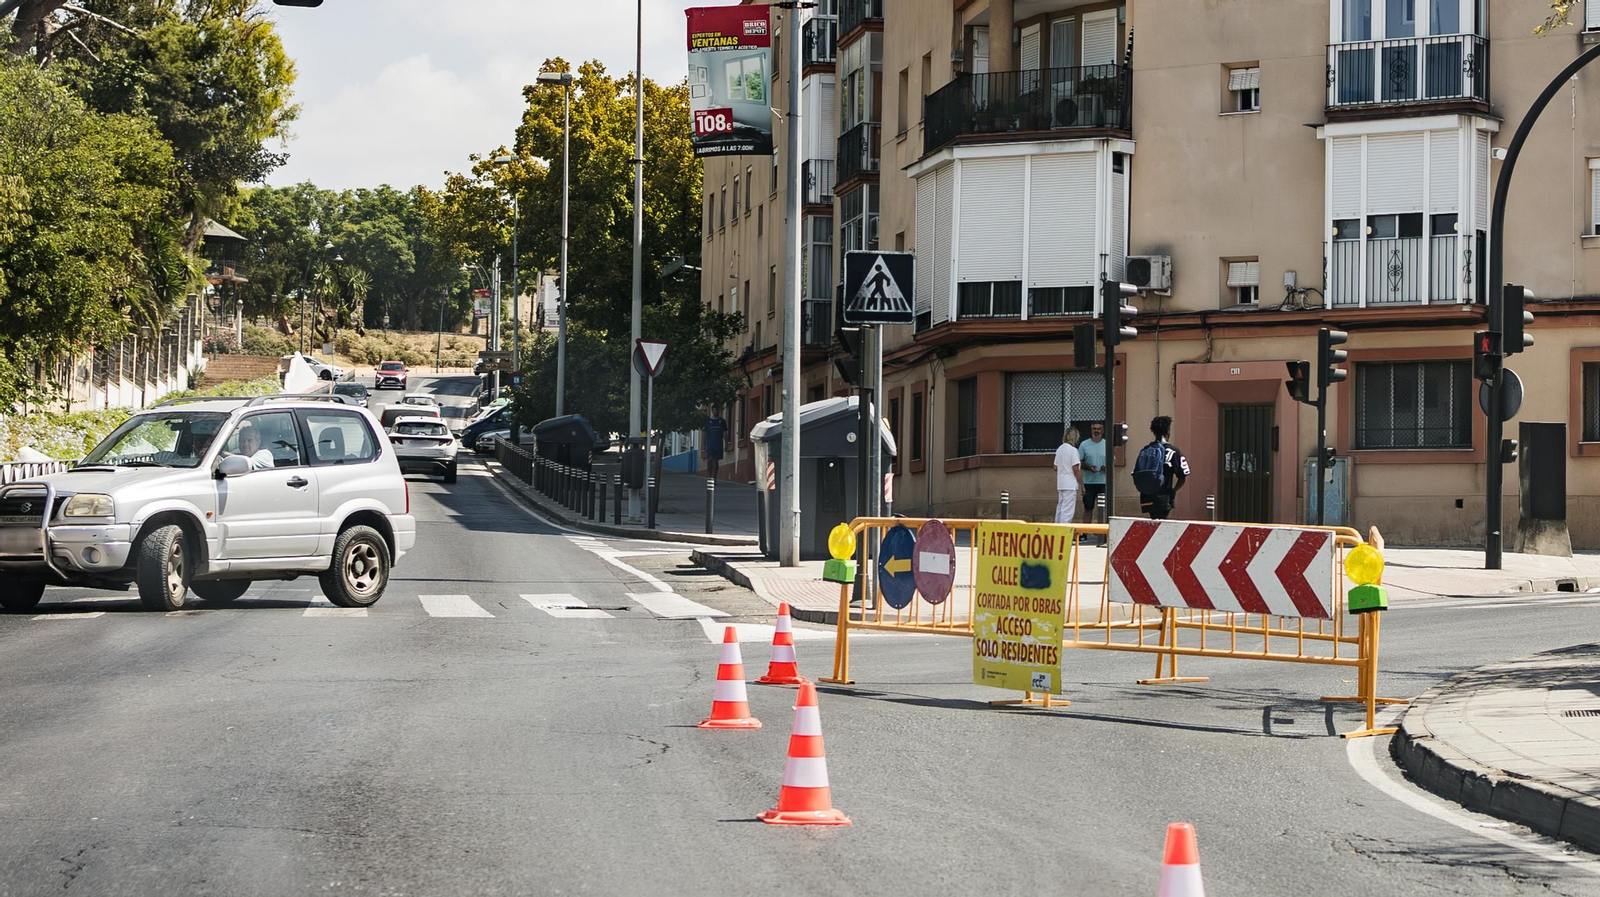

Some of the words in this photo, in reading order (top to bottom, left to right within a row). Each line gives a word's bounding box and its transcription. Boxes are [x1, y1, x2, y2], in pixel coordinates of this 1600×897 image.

[692, 37, 738, 47] VENTANAS
[992, 566, 1018, 586] CALLE
[978, 592, 1011, 610] CORTADA
[1013, 596, 1030, 612] POR
[1032, 597, 1061, 615] OBRAS
[996, 616, 1032, 636] ACCESO
[976, 638, 998, 658] SOLO
[1001, 641, 1058, 665] RESIDENTES
